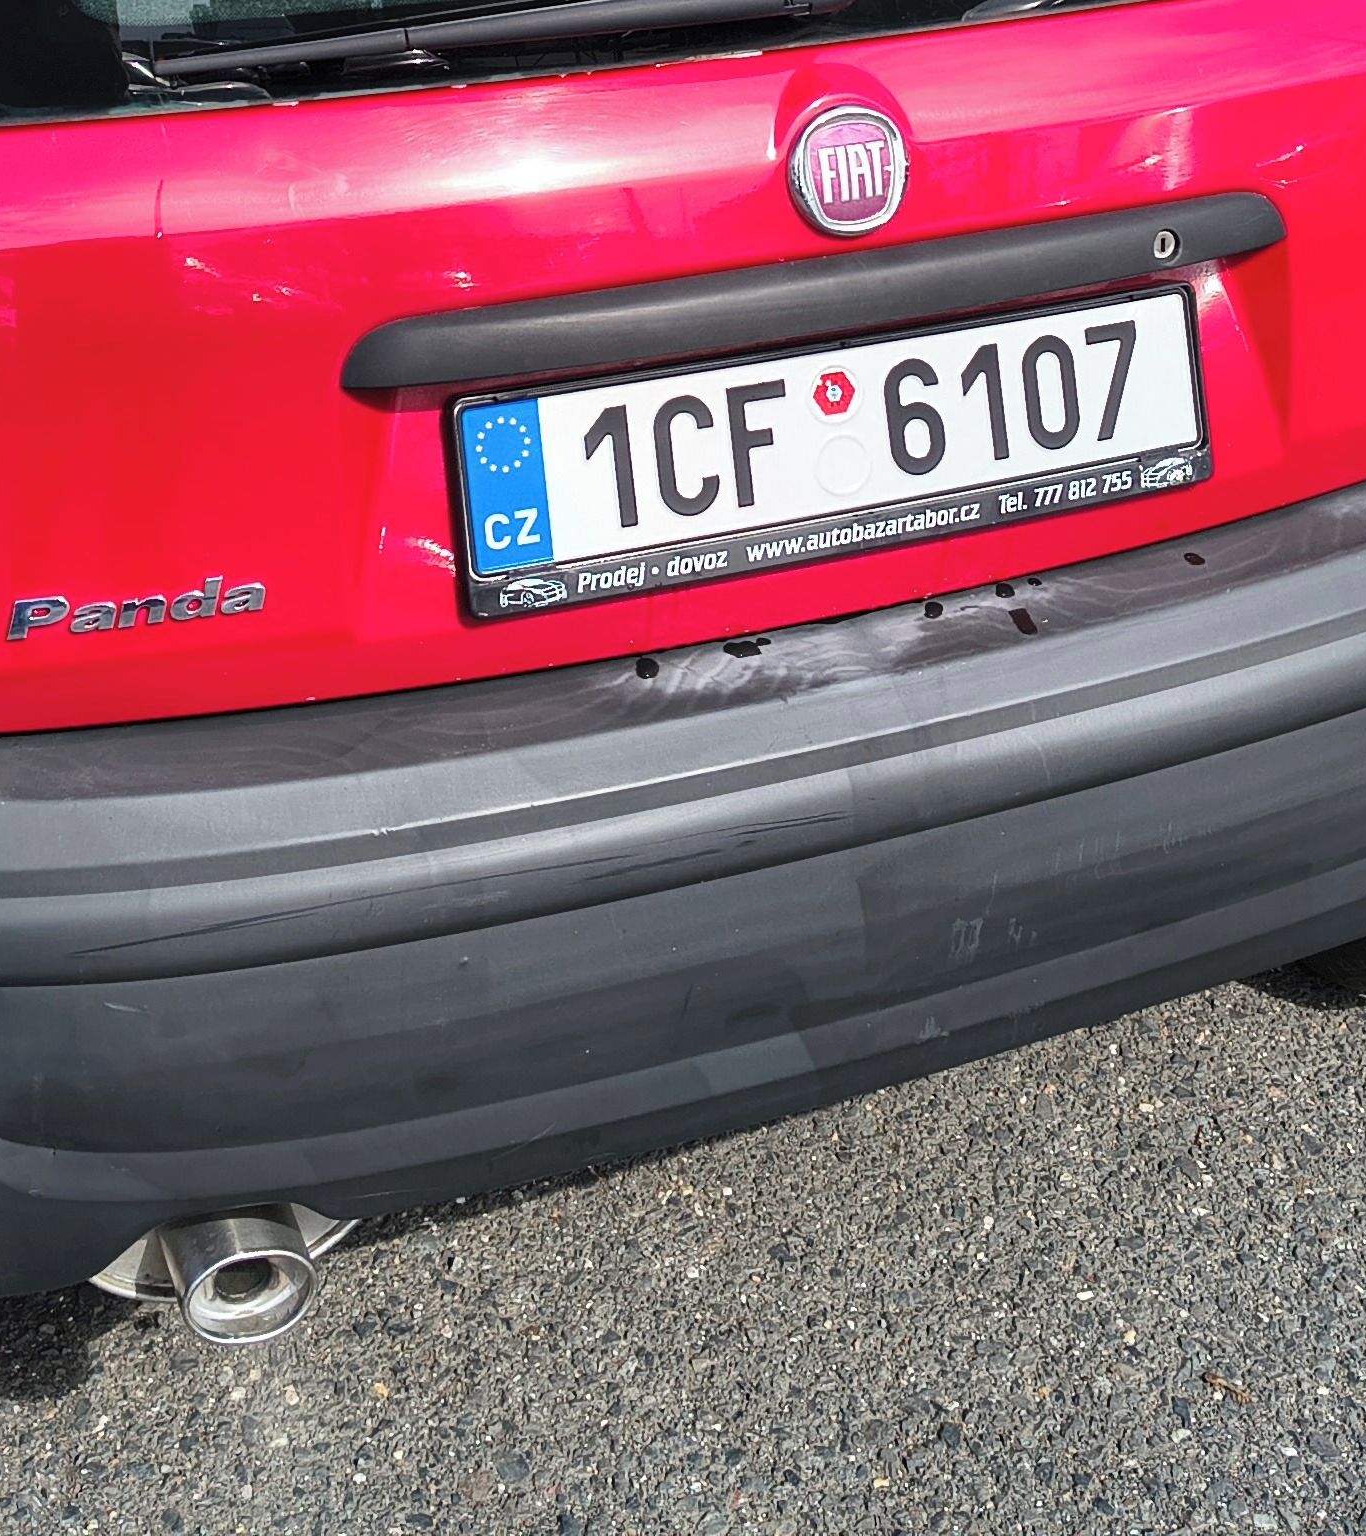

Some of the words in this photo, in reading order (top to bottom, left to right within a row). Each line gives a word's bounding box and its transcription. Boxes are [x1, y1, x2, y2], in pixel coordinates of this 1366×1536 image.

[817, 140, 885, 205] FIAT
[584, 379, 787, 528] 1CF
[883, 320, 1137, 476] 6107
[484, 507, 541, 551] CZ
[577, 561, 646, 593] Prodej
[666, 550, 728, 578] dovoz
[746, 502, 981, 563] www.autobazartabor.cz
[998, 493, 1028, 516] Tel.
[1033, 484, 1063, 509] 777
[1067, 474, 1097, 501] 812
[1101, 469, 1133, 495] 755
[6, 575, 267, 641] Panda
